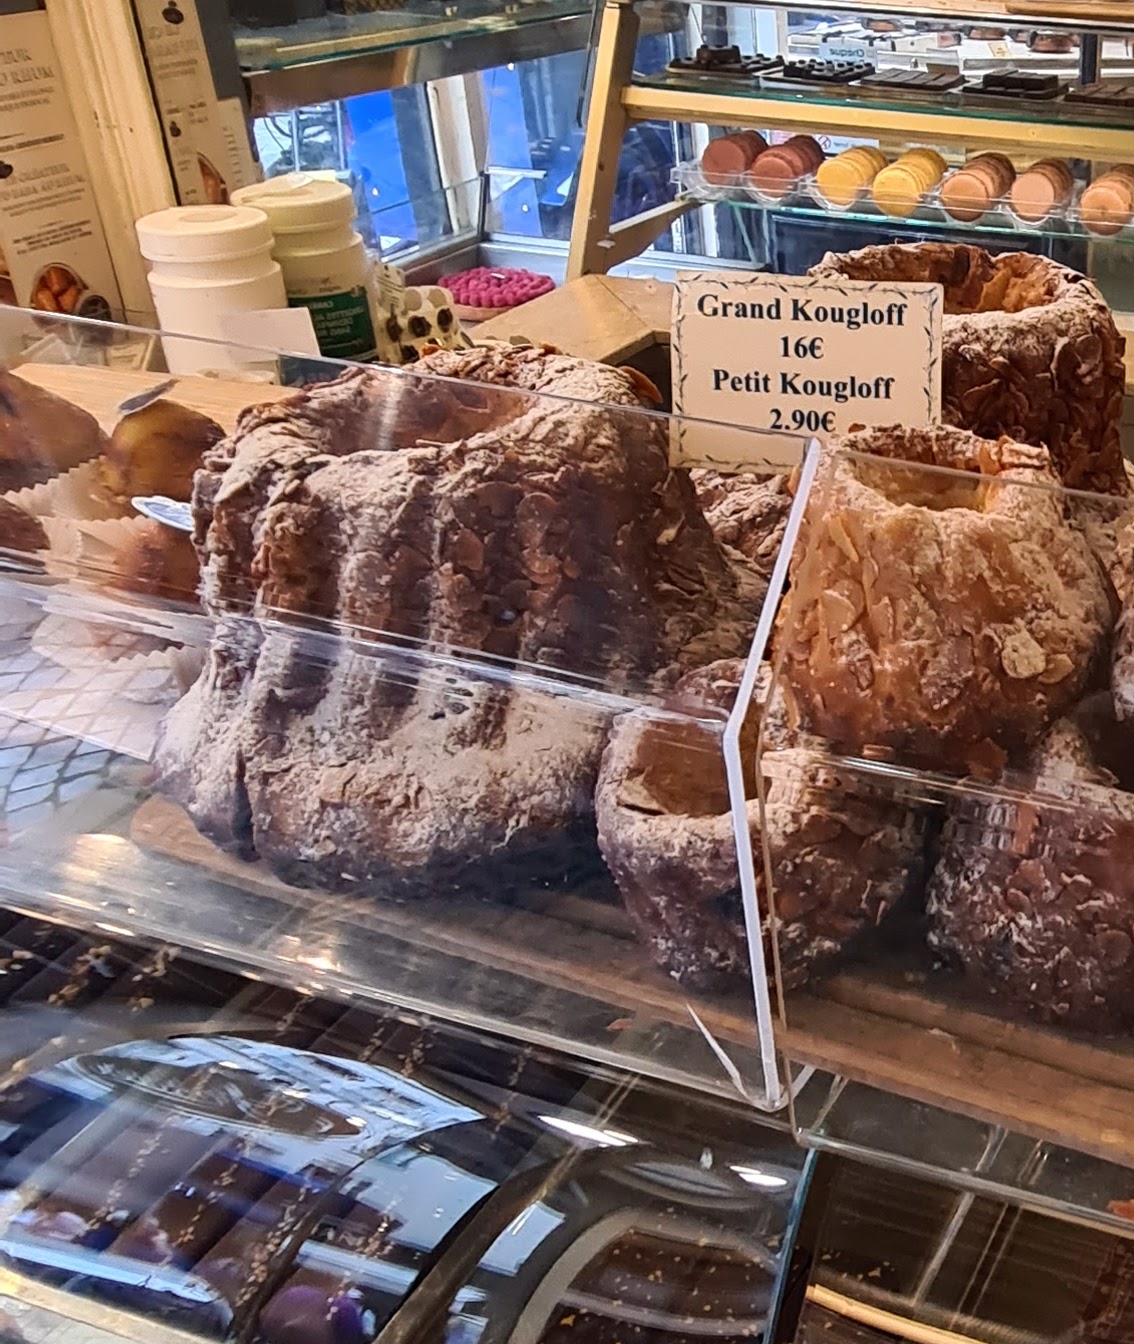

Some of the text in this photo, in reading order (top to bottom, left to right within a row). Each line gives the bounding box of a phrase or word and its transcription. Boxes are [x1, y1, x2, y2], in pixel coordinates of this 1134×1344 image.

[697, 293, 908, 330] Grand Kougloff
[780, 336, 825, 359] 16€
[712, 368, 896, 404] Petit Kougloff
[769, 408, 837, 433] 2.90€
